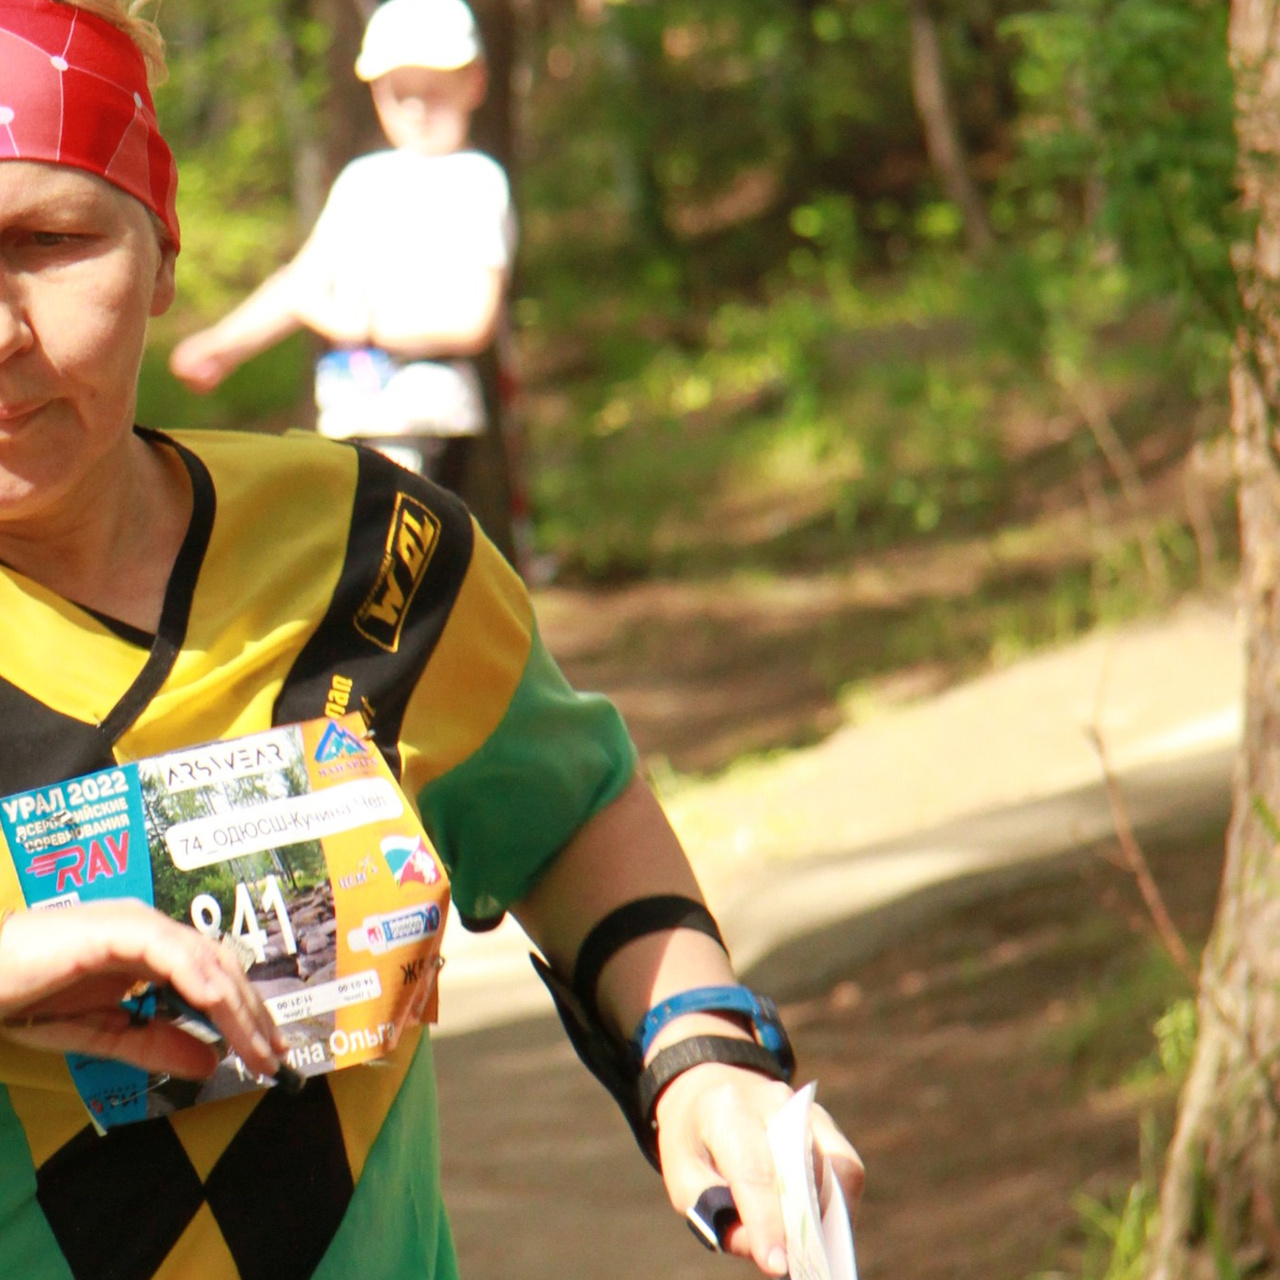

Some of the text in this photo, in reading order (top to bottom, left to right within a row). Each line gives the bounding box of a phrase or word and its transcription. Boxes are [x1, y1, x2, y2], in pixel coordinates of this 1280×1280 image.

[2, 770, 129, 823] УРАЛ 2022
[329, 1022, 395, 1057] Ольга
